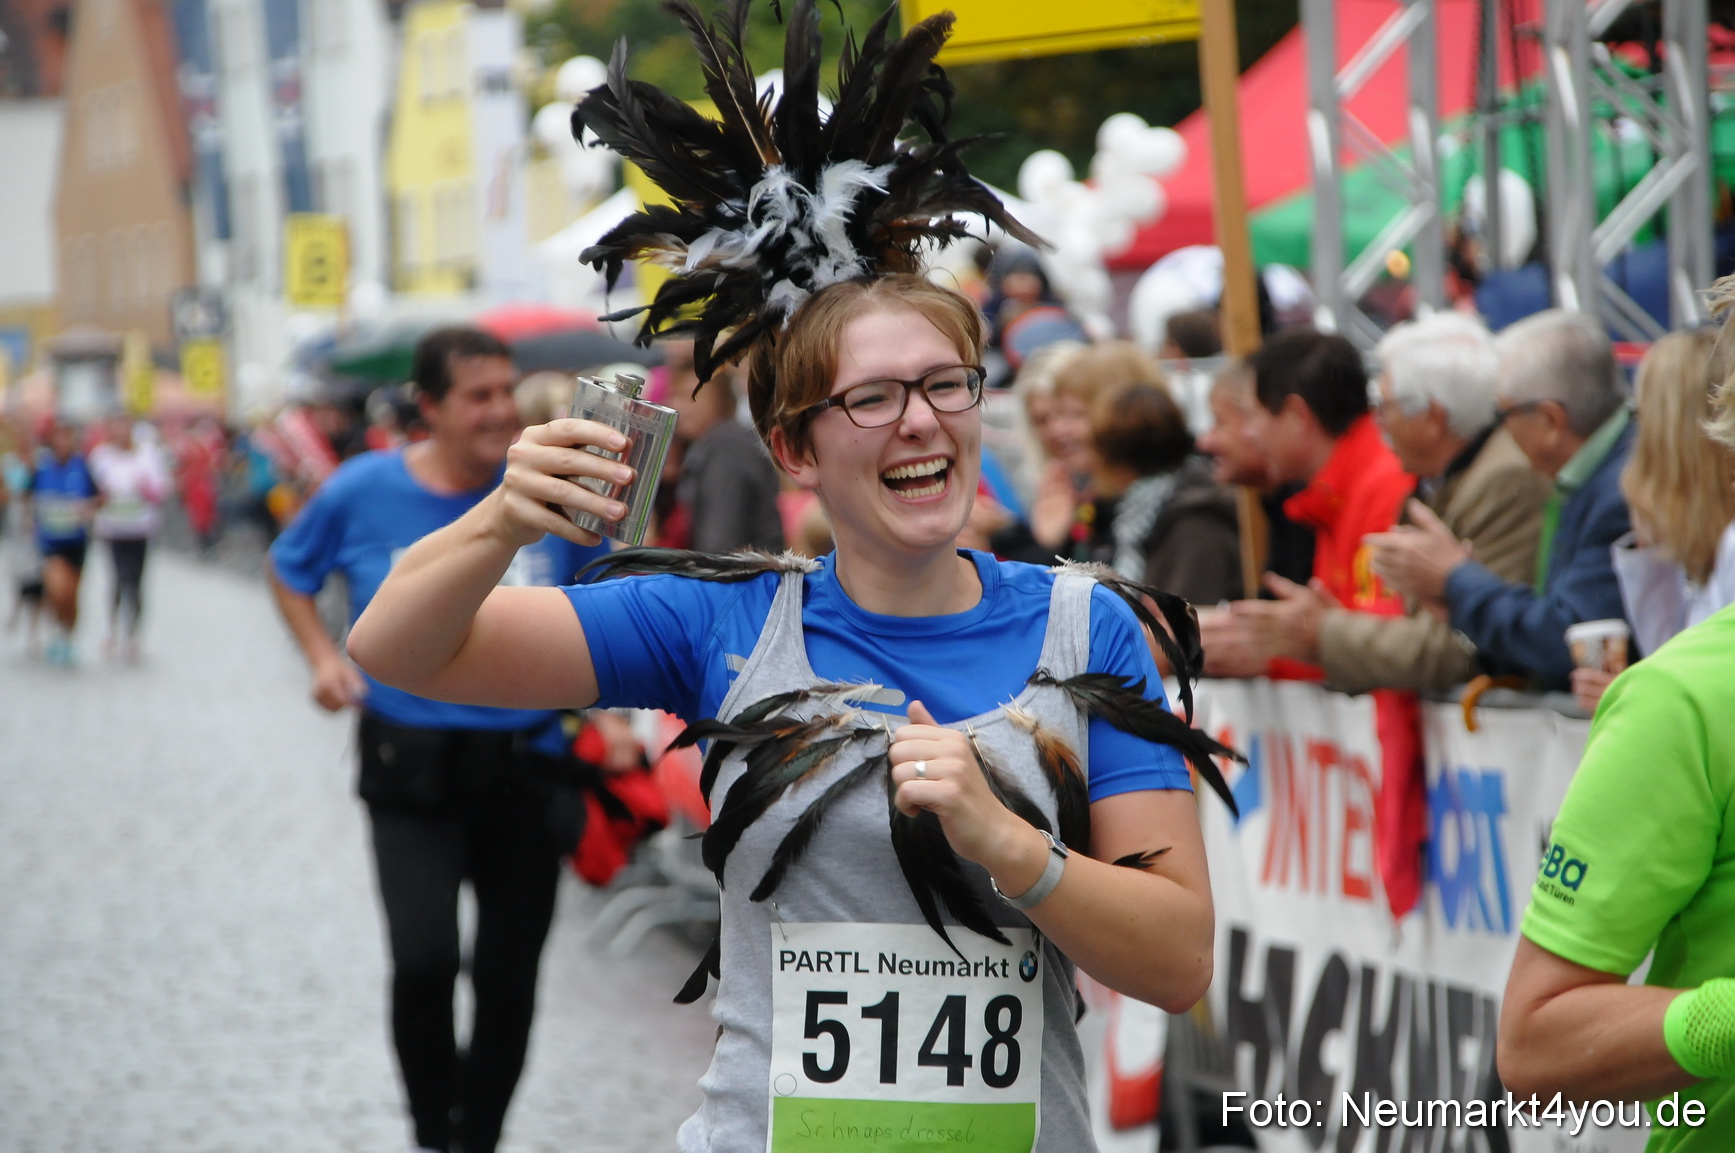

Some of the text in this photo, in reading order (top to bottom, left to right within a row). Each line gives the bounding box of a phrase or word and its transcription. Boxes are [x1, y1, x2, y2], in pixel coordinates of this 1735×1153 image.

[779, 949, 870, 974] PARTL
[878, 952, 1010, 979] Neumarkt
[801, 989, 1023, 1089] 5148
